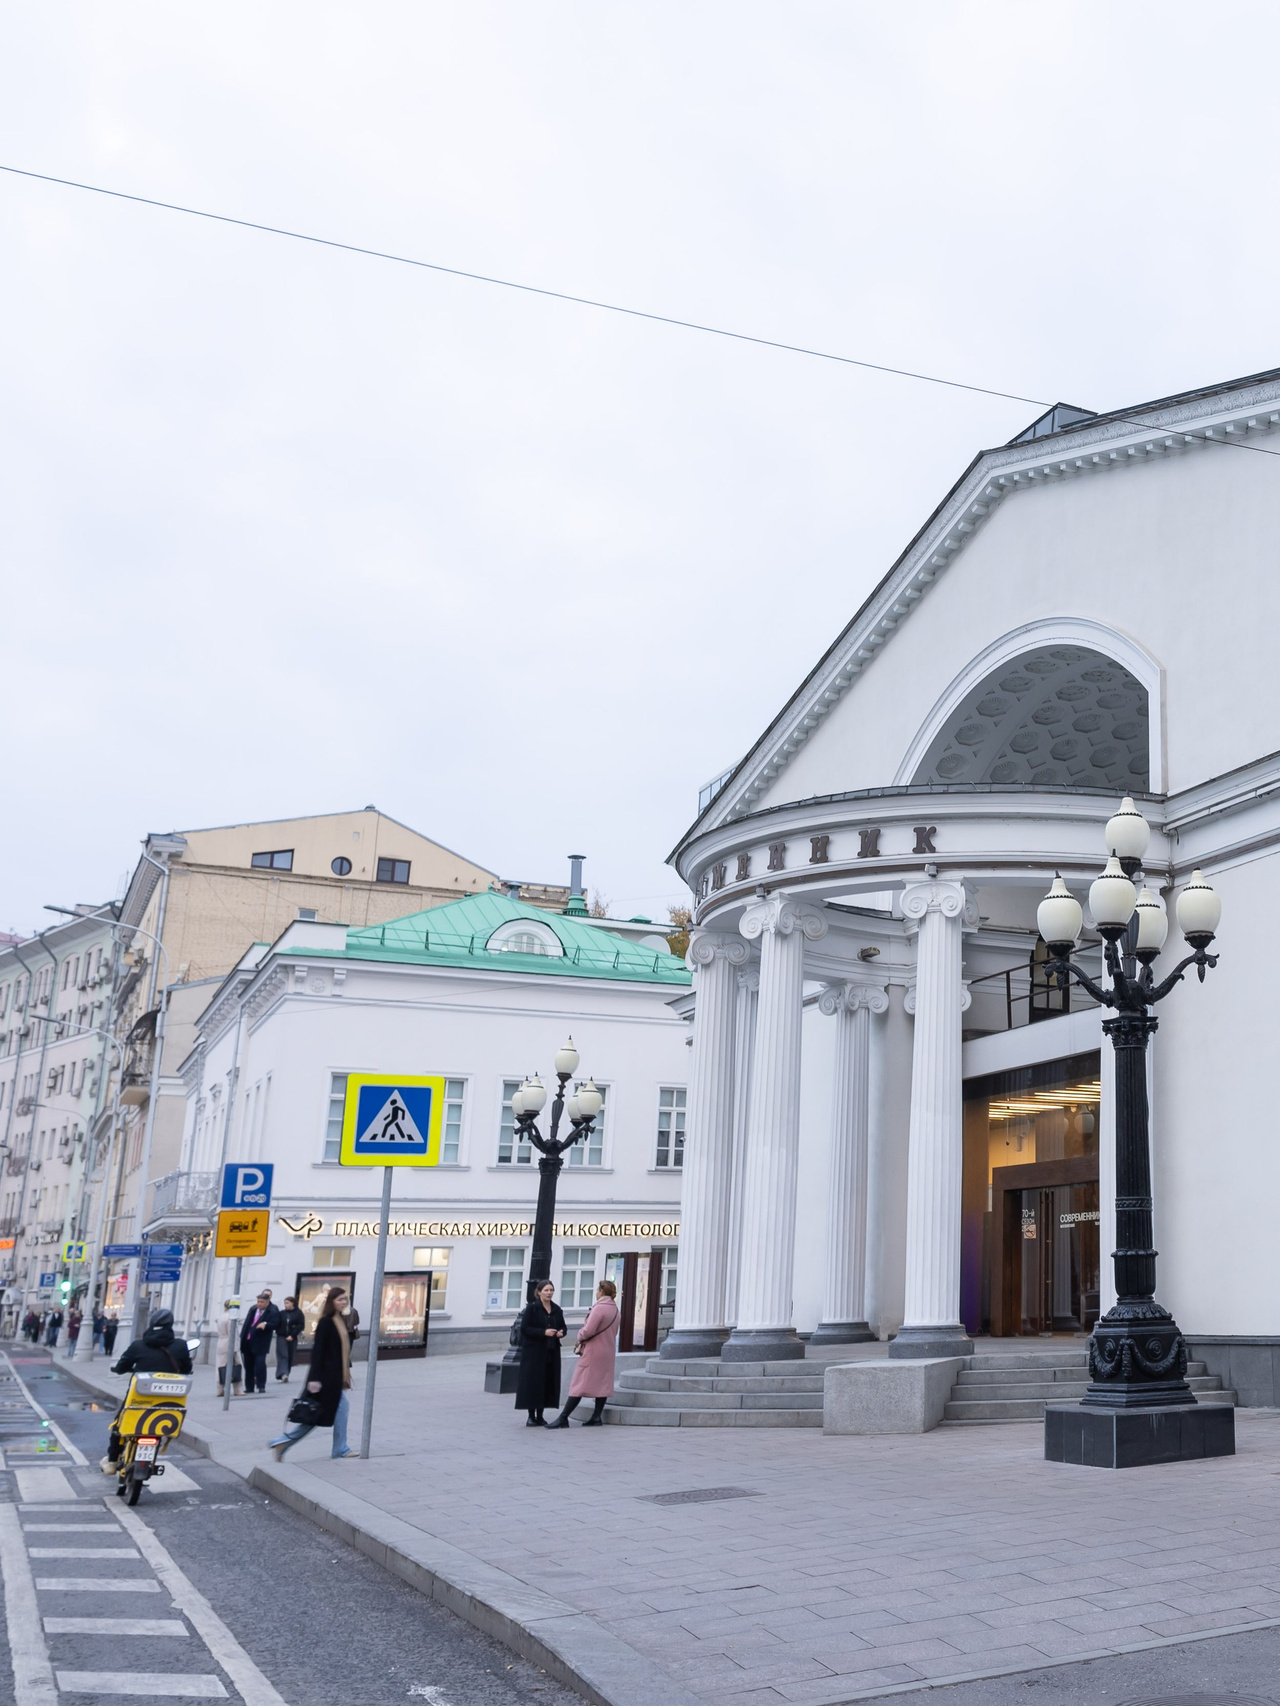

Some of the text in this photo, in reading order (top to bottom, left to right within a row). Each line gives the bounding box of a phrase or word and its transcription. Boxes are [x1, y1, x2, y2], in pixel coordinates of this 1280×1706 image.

[235, 1168, 264, 1204] P
[476, 1222, 558, 1236] ХИРУРГЯ
[563, 1223, 574, 1236] И
[578, 1223, 680, 1236] КОСМЕТОЛОГ
[165, 1385, 184, 1393] 1175
